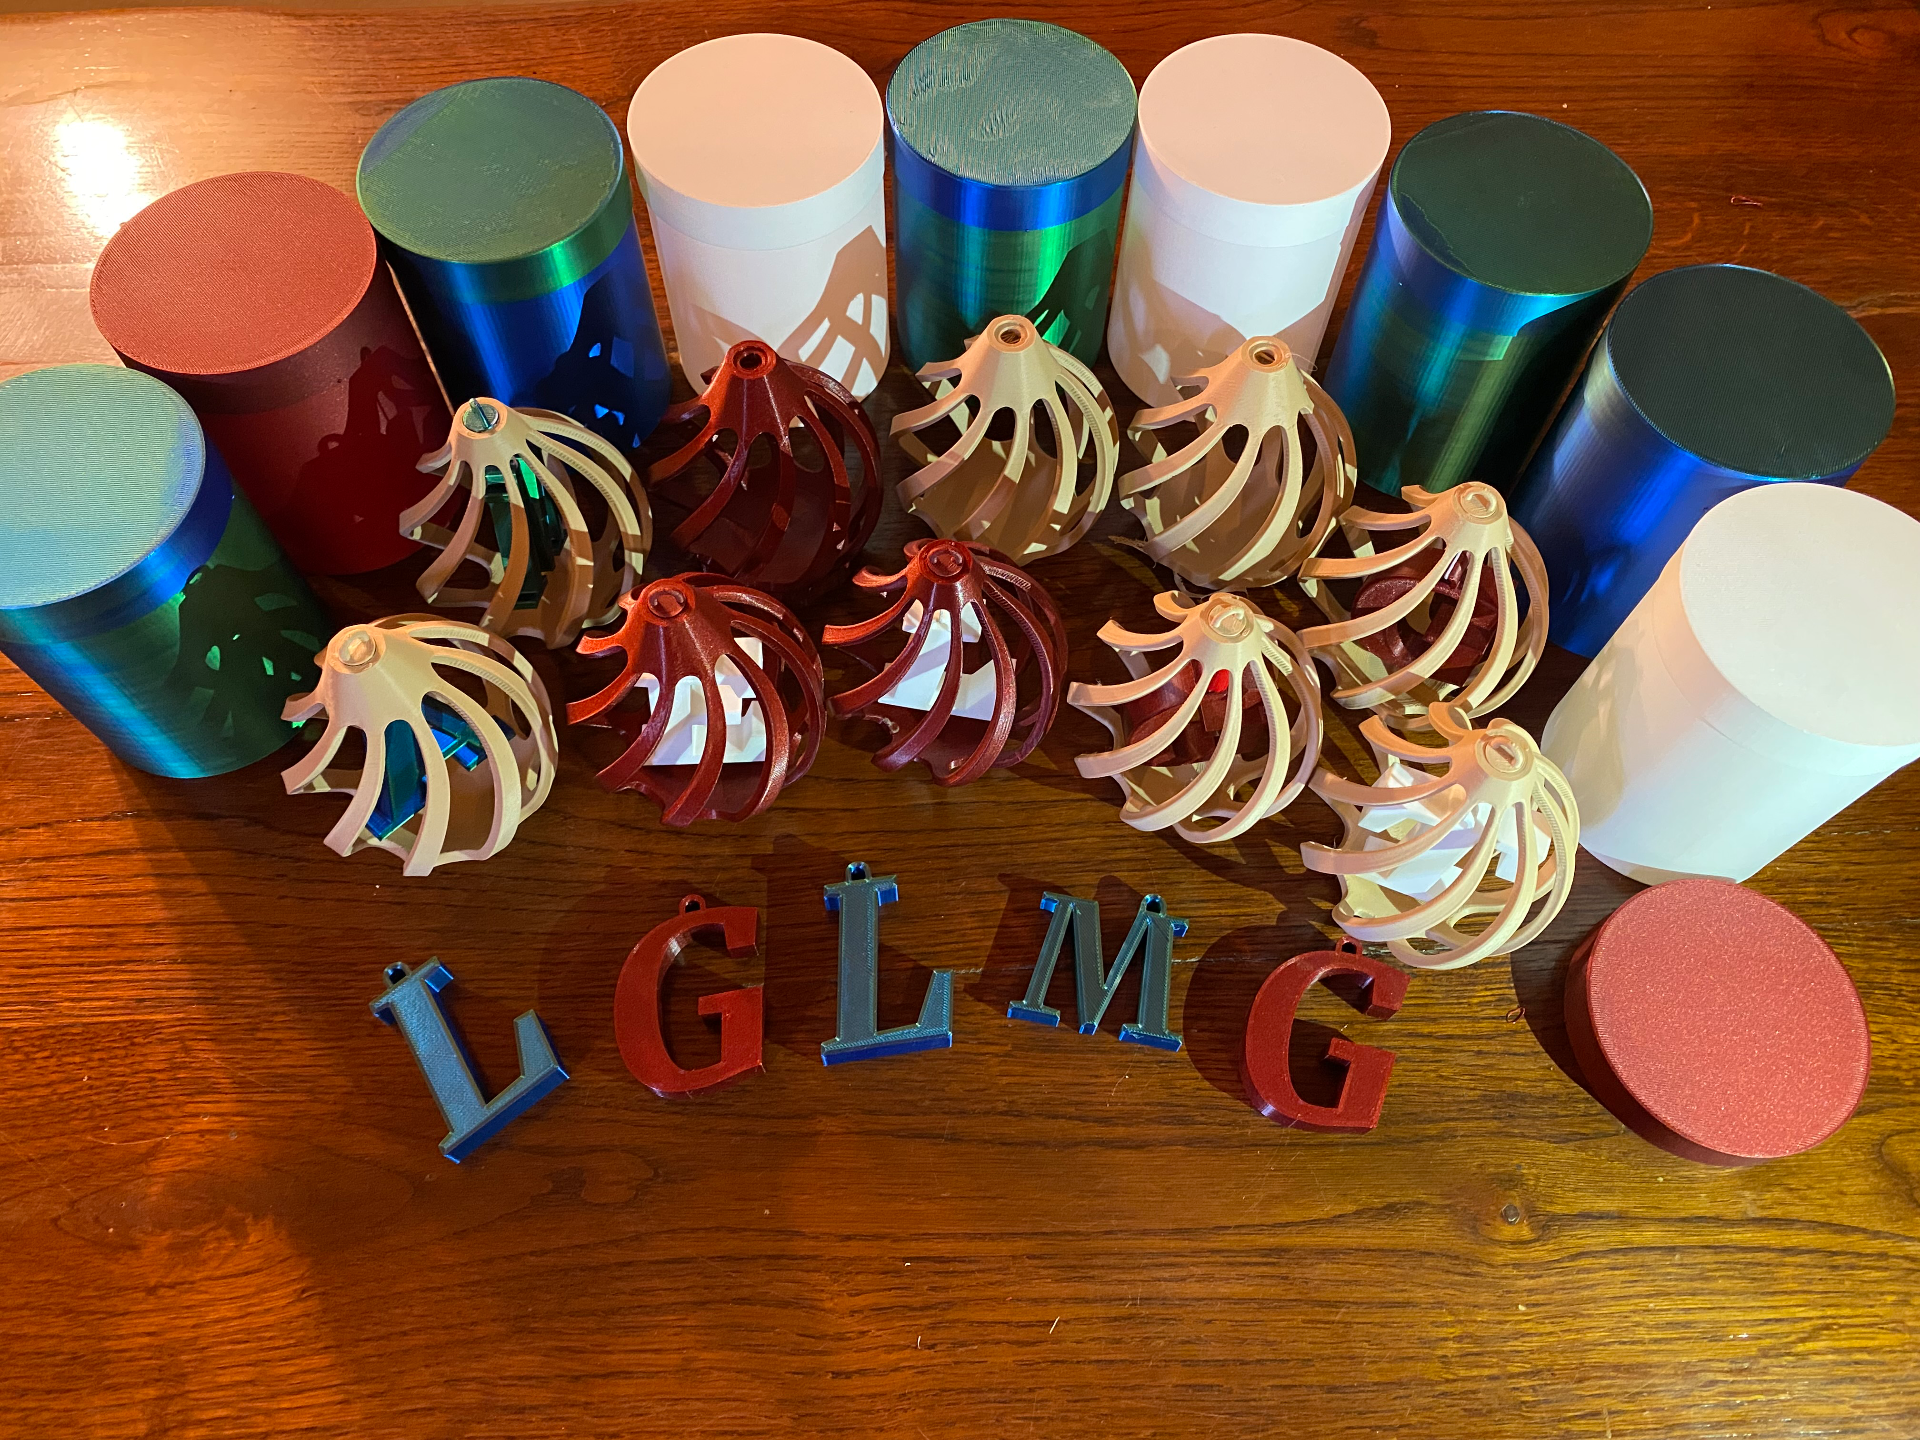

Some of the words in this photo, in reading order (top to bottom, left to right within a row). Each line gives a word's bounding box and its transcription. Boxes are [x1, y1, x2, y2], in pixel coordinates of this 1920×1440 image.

[370, 957, 569, 1164] L
[614, 904, 765, 1097] G
[821, 866, 953, 1067] L
[1007, 892, 1189, 1052] M
[1240, 948, 1411, 1134] G
